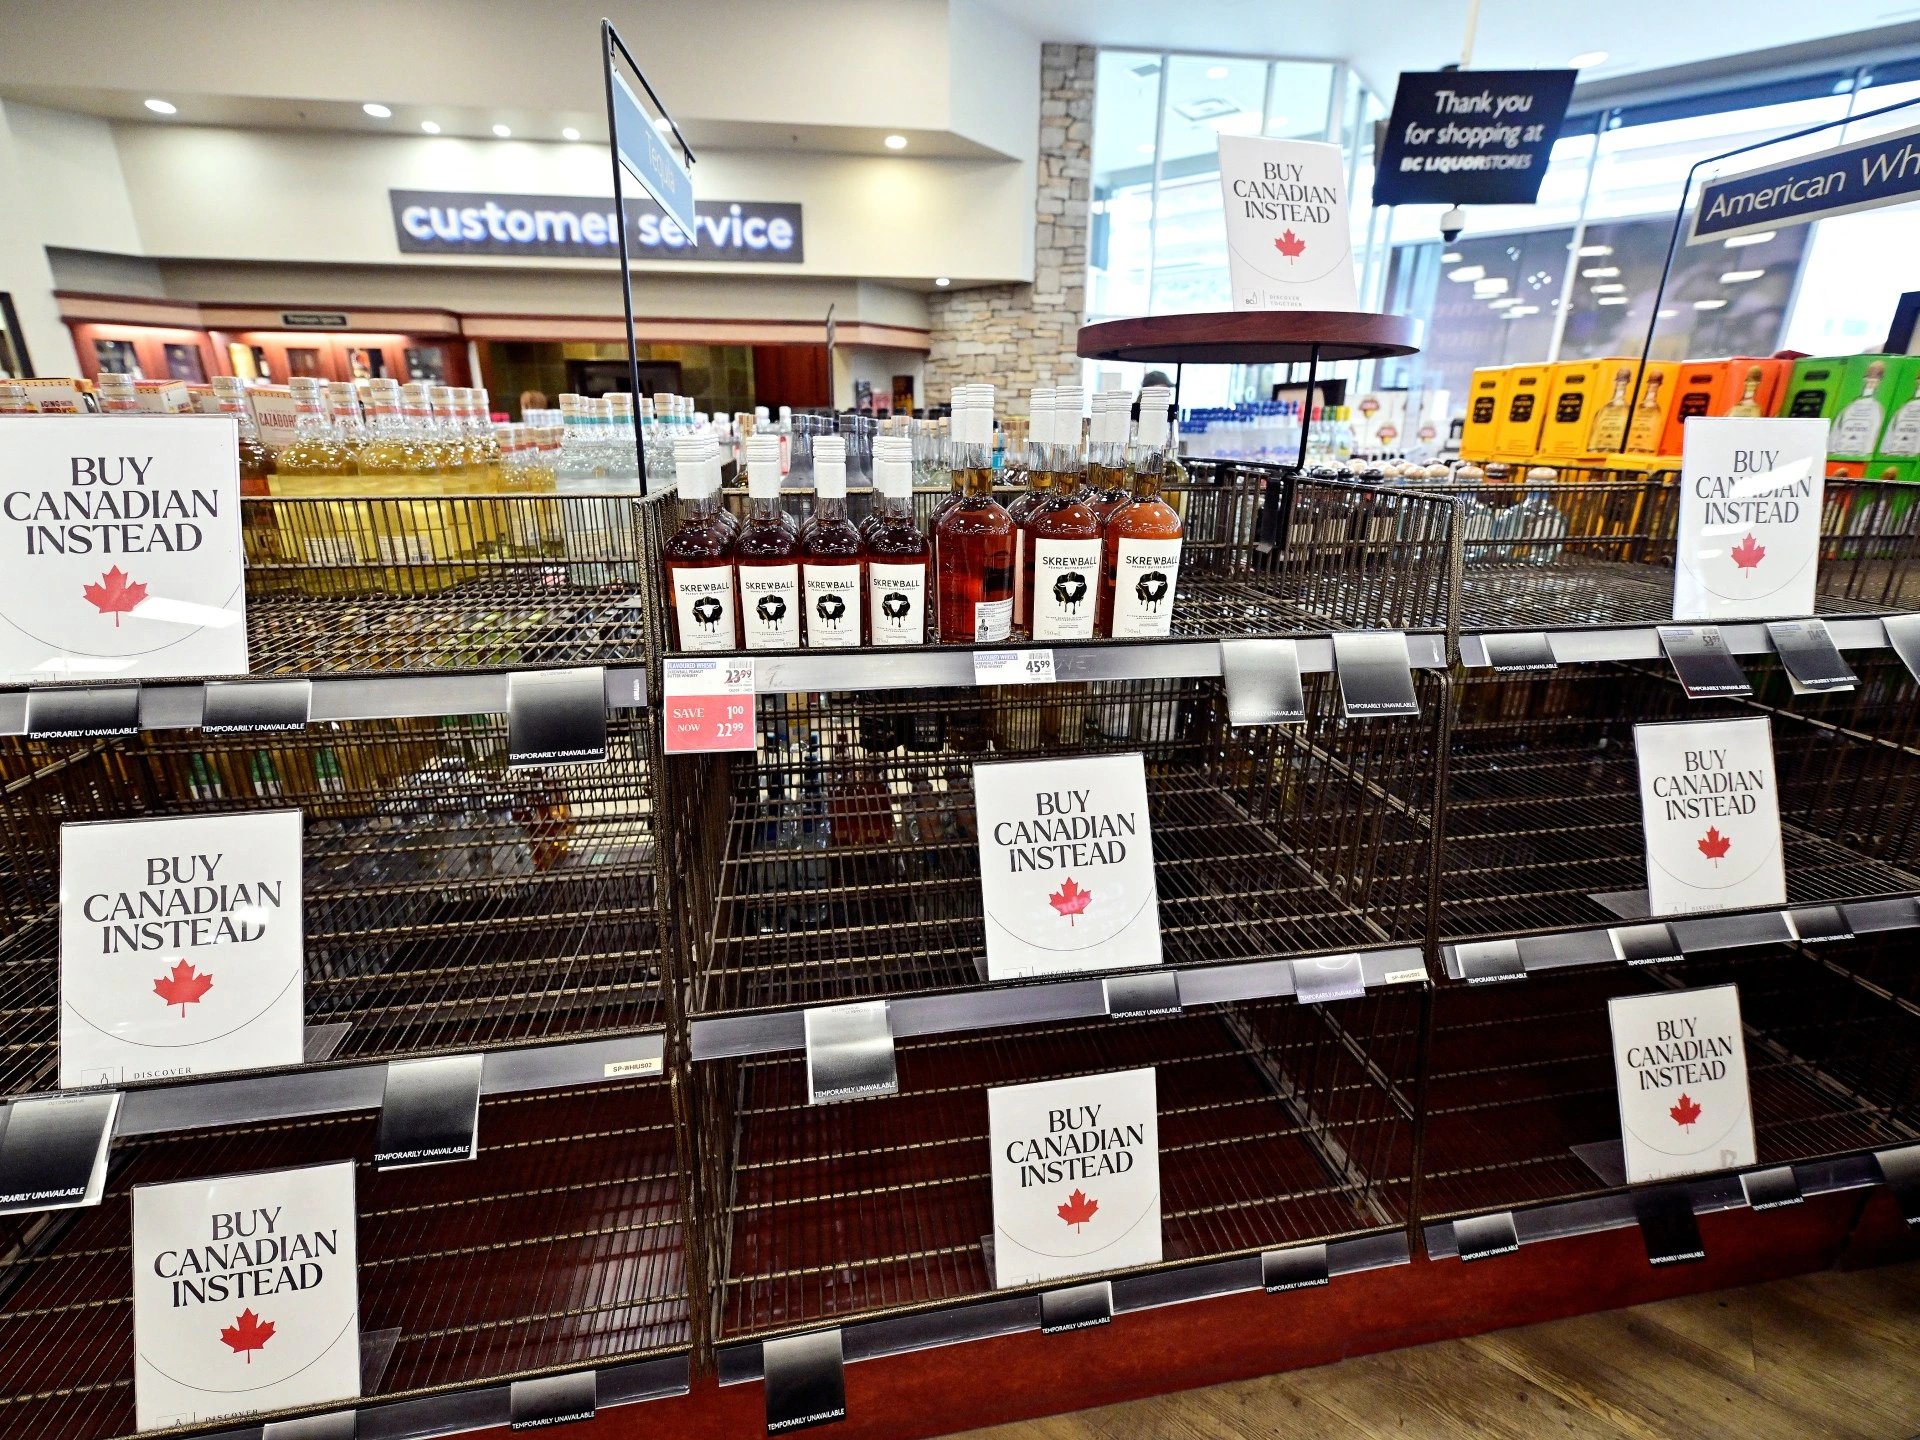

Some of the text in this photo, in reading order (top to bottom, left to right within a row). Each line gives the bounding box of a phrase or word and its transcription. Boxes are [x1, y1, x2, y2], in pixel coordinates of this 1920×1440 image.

[1434, 89, 1533, 119] Thank you
[1404, 121, 1545, 149] for shopping at
[1263, 162, 1303, 182] BUY
[1400, 157, 1423, 173] BC
[1233, 179, 1337, 205] CANADIAN
[1705, 171, 1846, 222] American
[400, 201, 627, 244] customer
[1245, 200, 1330, 224] INSTEAD
[70, 456, 154, 486] BUY
[1733, 450, 1779, 473] BUY
[3, 489, 219, 521] CANADIAN
[1704, 501, 1799, 525] INSTEAD
[26, 523, 203, 555] INSTEAD
[1042, 556, 1097, 566] SKREWBALL
[1126, 555, 1178, 565] SKREWBALL
[680, 582, 730, 592] SKREWBALL
[745, 580, 795, 590] SKREWBALL
[807, 580, 855, 589] SKREWBALL
[873, 578, 920, 588] SKREWBALL
[673, 708, 705, 719] SAVE
[30, 726, 138, 739] TEMPORARILY UNAVAILABLE
[202, 722, 305, 733] TEMPORARILY UNAVAILABLE
[677, 724, 701, 732] NOW
[509, 748, 604, 760] TEMPORARILY UNAVAILABLE
[1685, 750, 1726, 772] BUY
[1653, 770, 1764, 798] CANADIAN
[1036, 790, 1090, 816] BUY
[1665, 794, 1756, 820] INSTEAD
[994, 813, 1135, 846] CANADIAN
[1009, 840, 1126, 872] INSTEAD
[147, 854, 223, 886] BUY
[83, 880, 282, 922] CANADIAN
[102, 915, 266, 954] INSTEAD
[1111, 1007, 1182, 1019] TEMPORARILY UNAVAILABLE
[1656, 1017, 1697, 1041] BUY
[1627, 1036, 1732, 1069] CANADIAN
[134, 1067, 192, 1079] DISCOVER
[1639, 1060, 1726, 1090] INSTEAD
[814, 1081, 896, 1098] TEMPORARILY UNAVAILABLE
[1049, 1104, 1102, 1133] BUY
[374, 1145, 470, 1162] TEMPORARILY UNAVAILABLE
[1006, 1124, 1144, 1164] CANADIAN
[1020, 1151, 1134, 1187] INSTEAD
[31, 1186, 85, 1199] UNAVAILABLE
[211, 1206, 282, 1240] BUY
[154, 1229, 337, 1279] CANADIAN
[172, 1262, 323, 1307] INSTEAD
[1266, 1277, 1329, 1293] TEMPORARILY UNAVAILABLE
[1042, 1317, 1111, 1334] TEMPORARILY UNAVAILABLE
[512, 1410, 595, 1429] TEMPORARILY UNAVAILABLE
[768, 1407, 845, 1430] TEMPORARILY UNAVAILABLE
